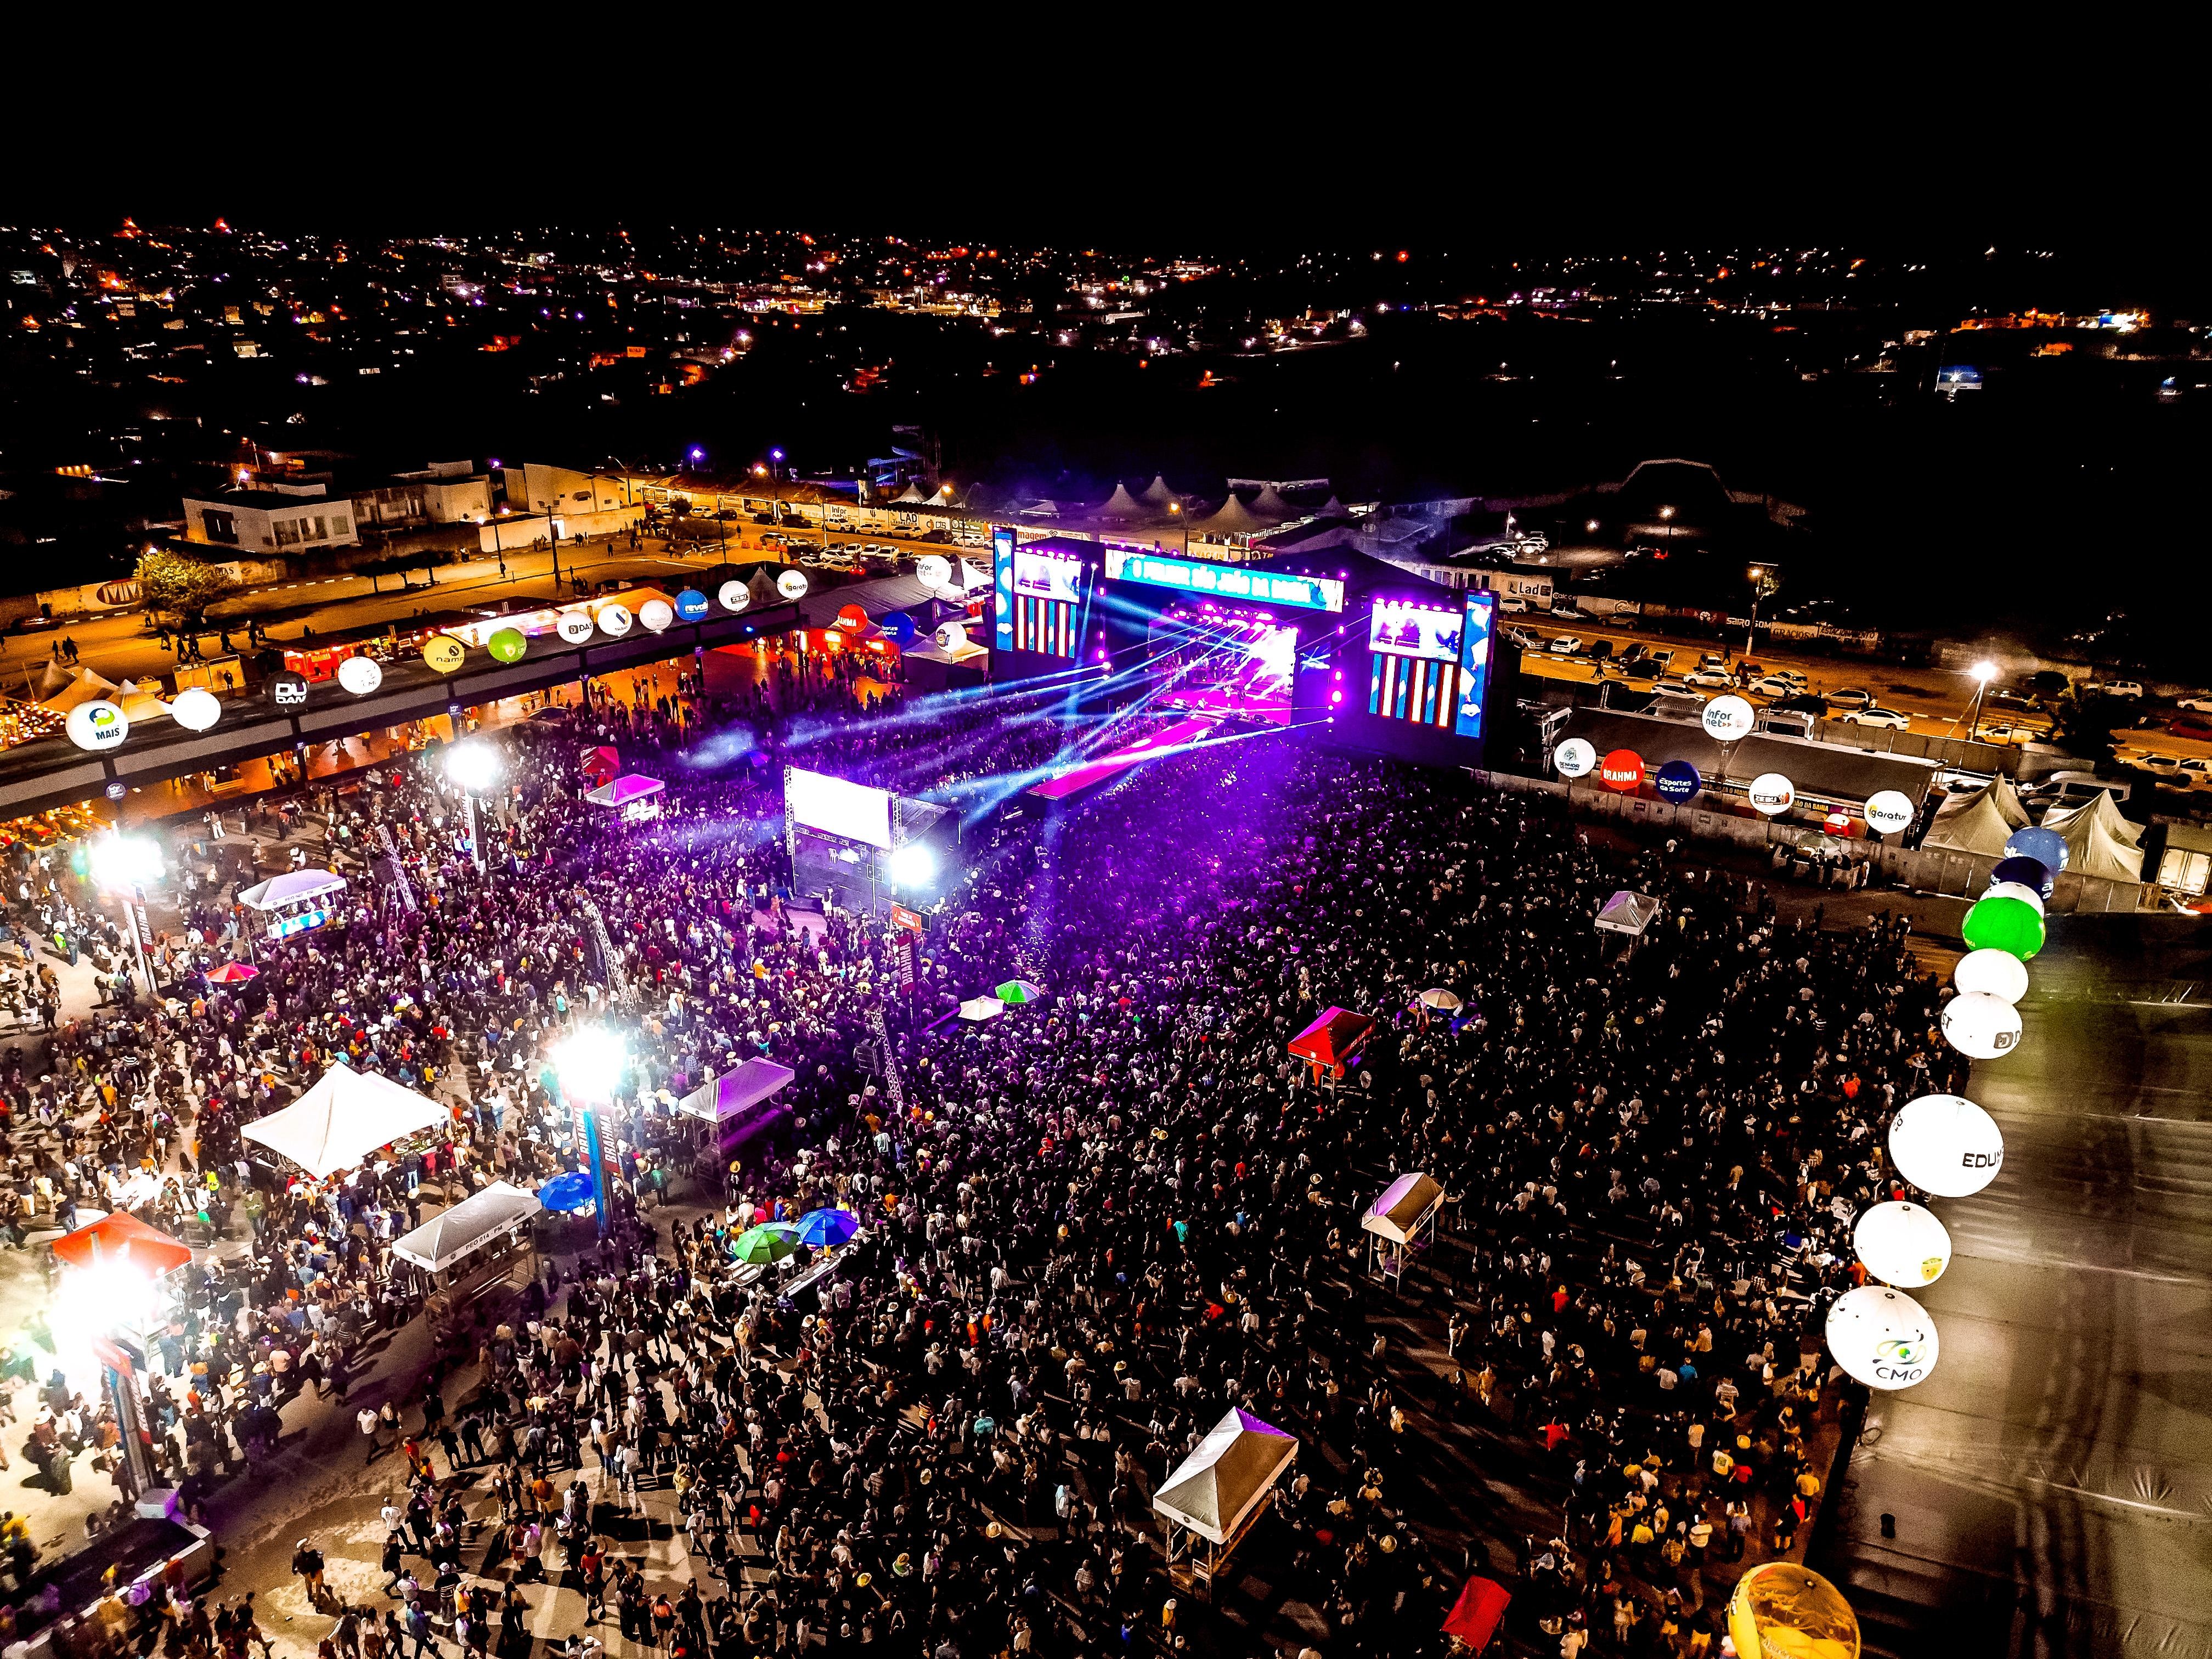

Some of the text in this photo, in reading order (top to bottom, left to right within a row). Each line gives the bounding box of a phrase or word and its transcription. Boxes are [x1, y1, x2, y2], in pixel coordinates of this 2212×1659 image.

[900, 512, 917, 522] LAD
[1519, 582, 1539, 595] Lad
[1707, 708, 1733, 720] Infor
[95, 727, 120, 740] MAIS
[899, 942, 913, 985] BRAHMA
[599, 1114, 618, 1164] BRAHMA
[1876, 1367, 1922, 1381] CMO
